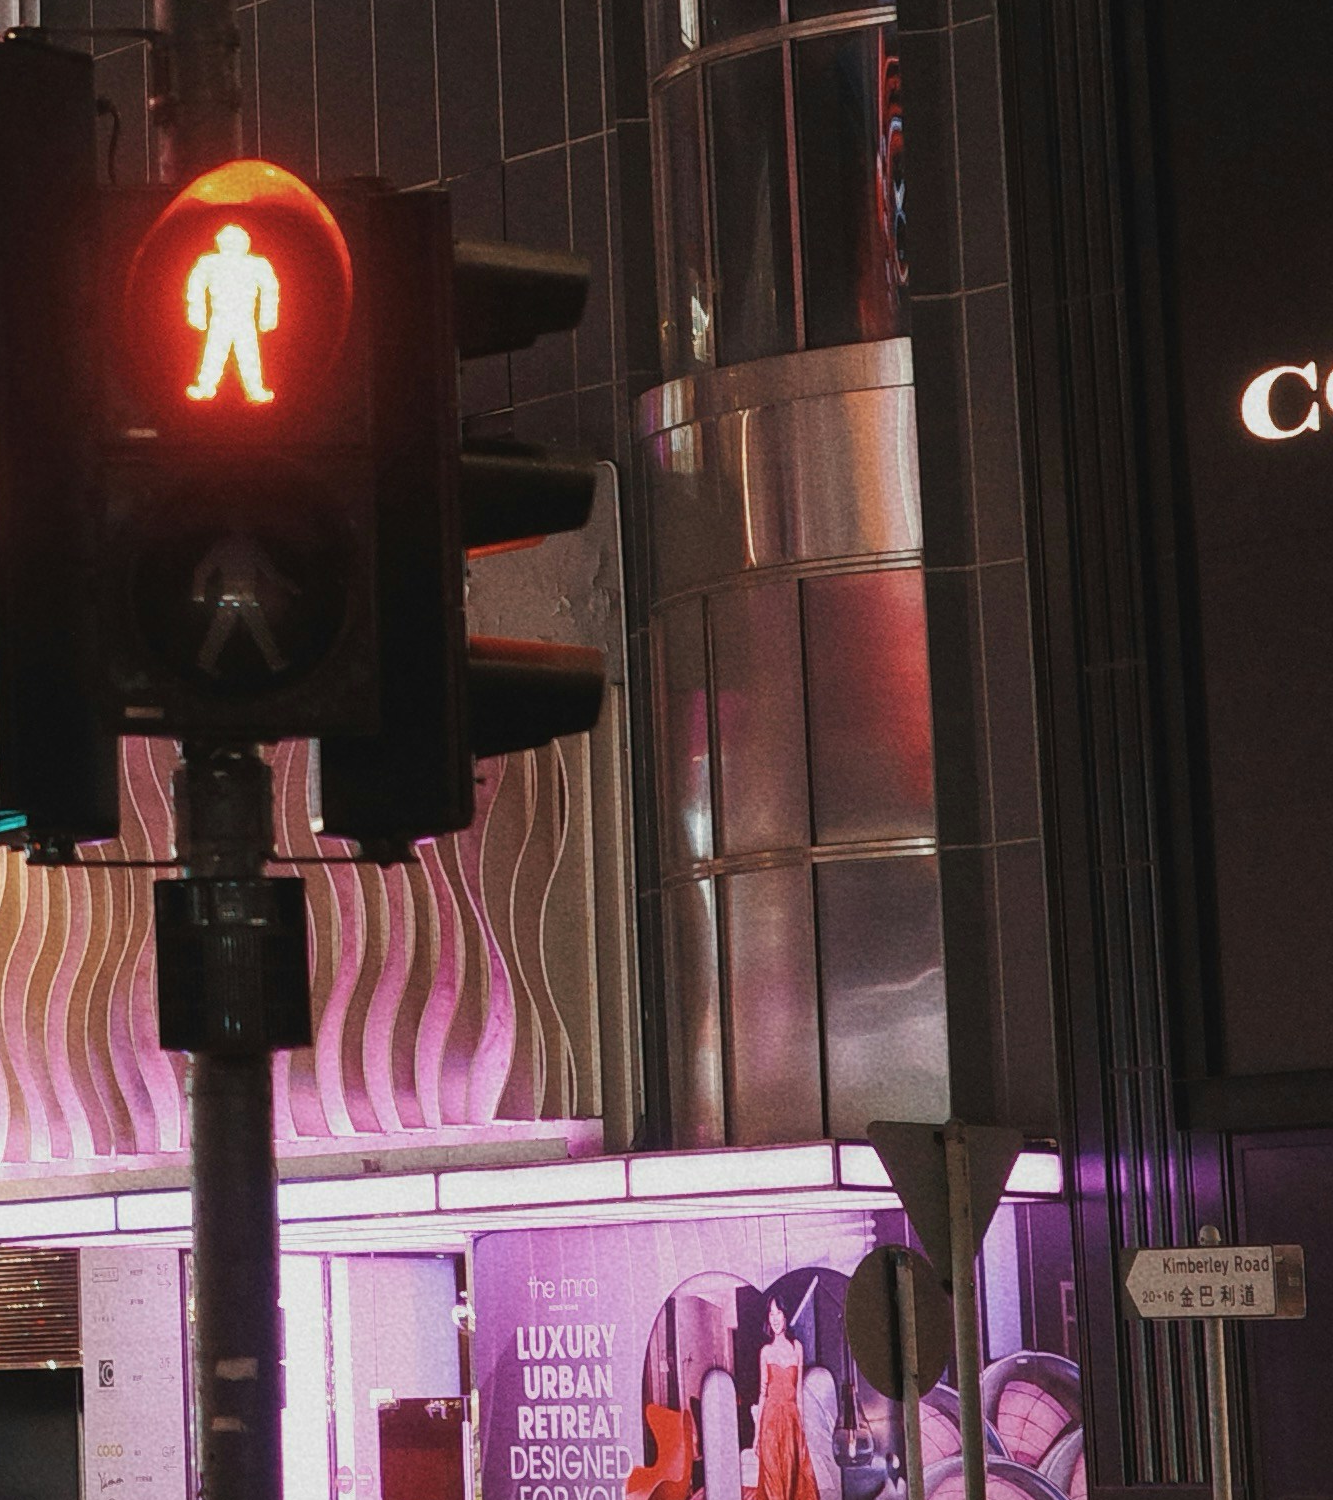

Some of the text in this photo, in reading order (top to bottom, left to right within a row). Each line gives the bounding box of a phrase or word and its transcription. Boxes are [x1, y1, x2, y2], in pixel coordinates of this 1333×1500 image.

[1241, 360, 1333, 440] C
[1162, 1255, 1270, 1277] Kimberley Road
[527, 1275, 599, 1299] the mira
[1180, 1283, 1255, 1308] 金巴利道
[516, 1323, 616, 1362] LUXURY
[523, 1364, 614, 1400] URBAN
[517, 1404, 624, 1440] RETREAT
[97, 1444, 123, 1457] COCO
[510, 1445, 633, 1481] DESIGNED
